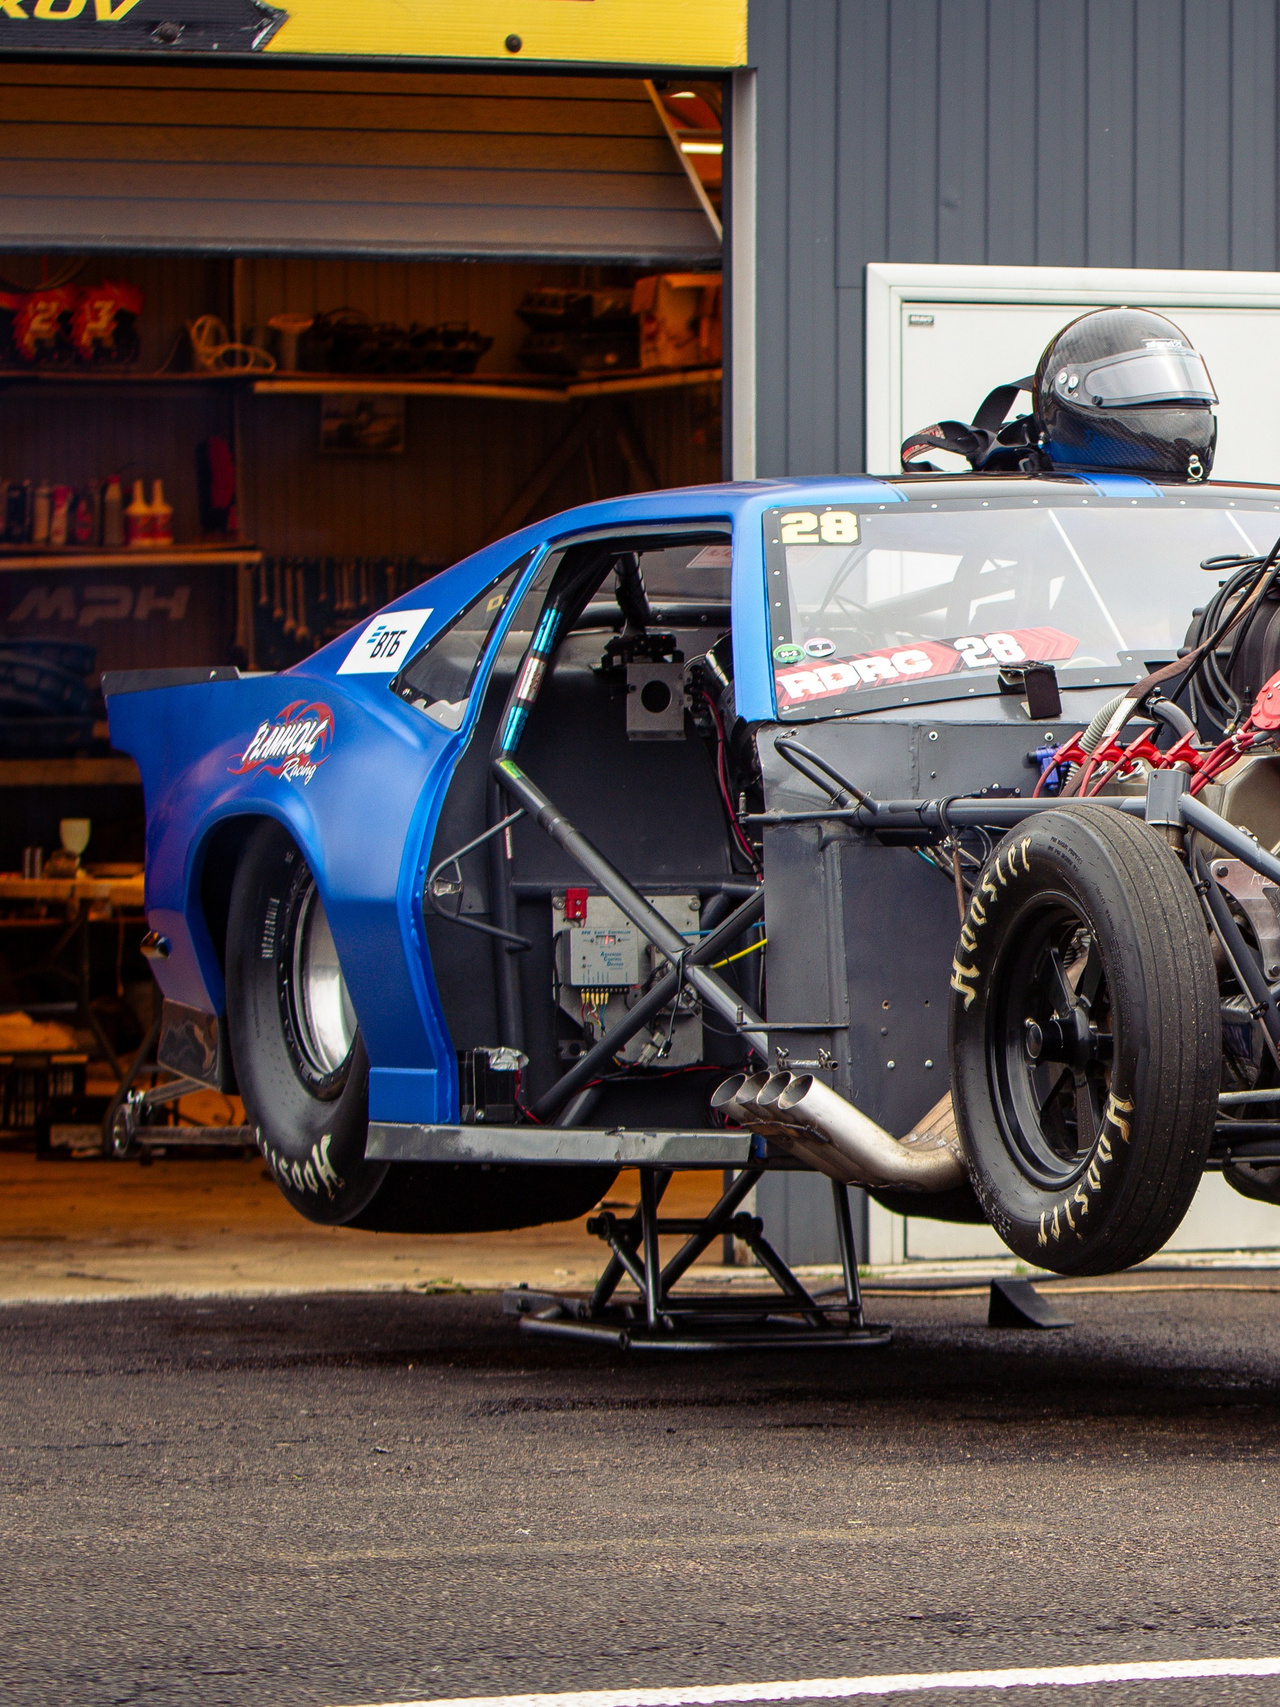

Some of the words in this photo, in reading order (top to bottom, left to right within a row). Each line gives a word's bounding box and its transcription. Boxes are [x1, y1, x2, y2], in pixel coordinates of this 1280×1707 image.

[780, 511, 859, 544] 28
[7, 584, 192, 628] MPH
[776, 649, 933, 699] RDRC
[953, 633, 1027, 668] 28
[279, 757, 317, 786] Racing
